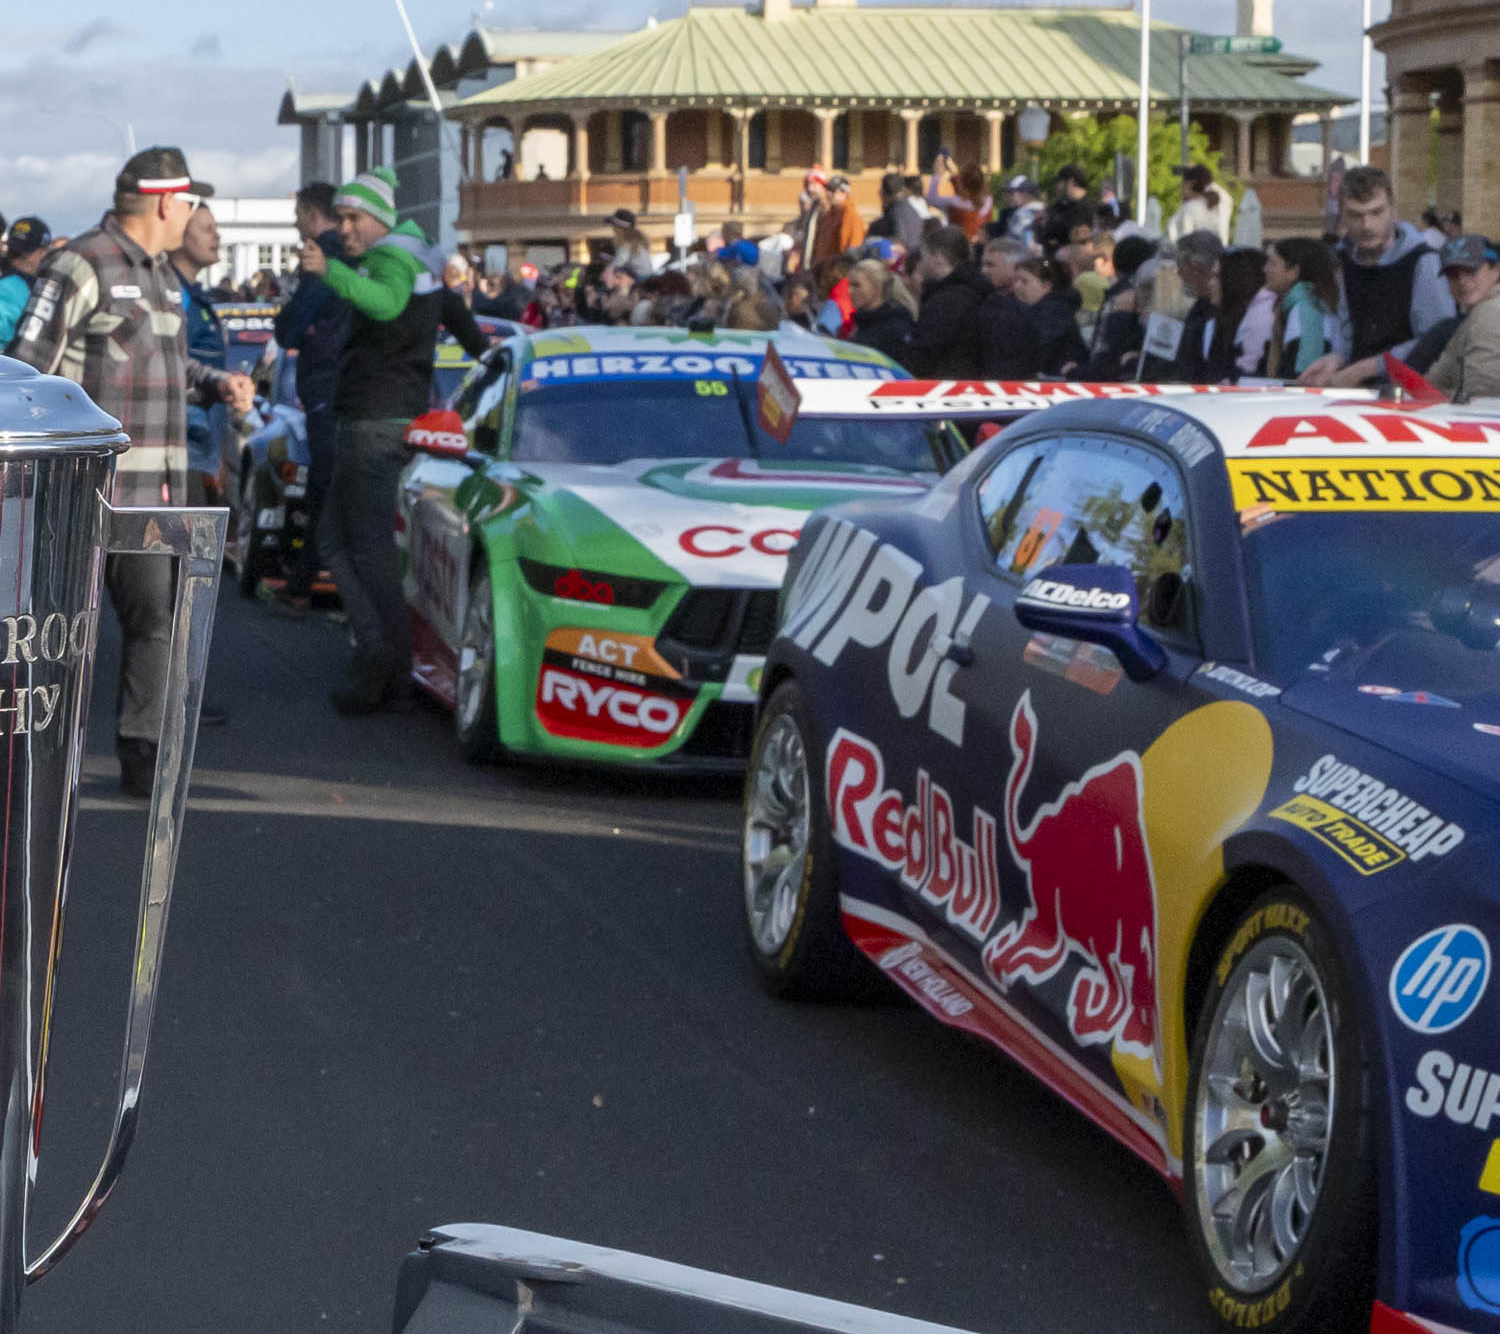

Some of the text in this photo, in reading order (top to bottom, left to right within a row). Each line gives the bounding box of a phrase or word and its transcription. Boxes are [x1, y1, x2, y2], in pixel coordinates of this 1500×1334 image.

[532, 354, 755, 379] HERZOG
[695, 380, 728, 396] 55
[1022, 579, 1131, 609] ACDelco
[578, 634, 639, 666] ACT
[541, 669, 680, 733] RYCO
[1293, 753, 1466, 863] SUPERCHEAP
[826, 726, 928, 891] Red
[921, 779, 999, 943] Bull
[1327, 822, 1391, 868] TRADE
[1401, 924, 1484, 1030] hp
